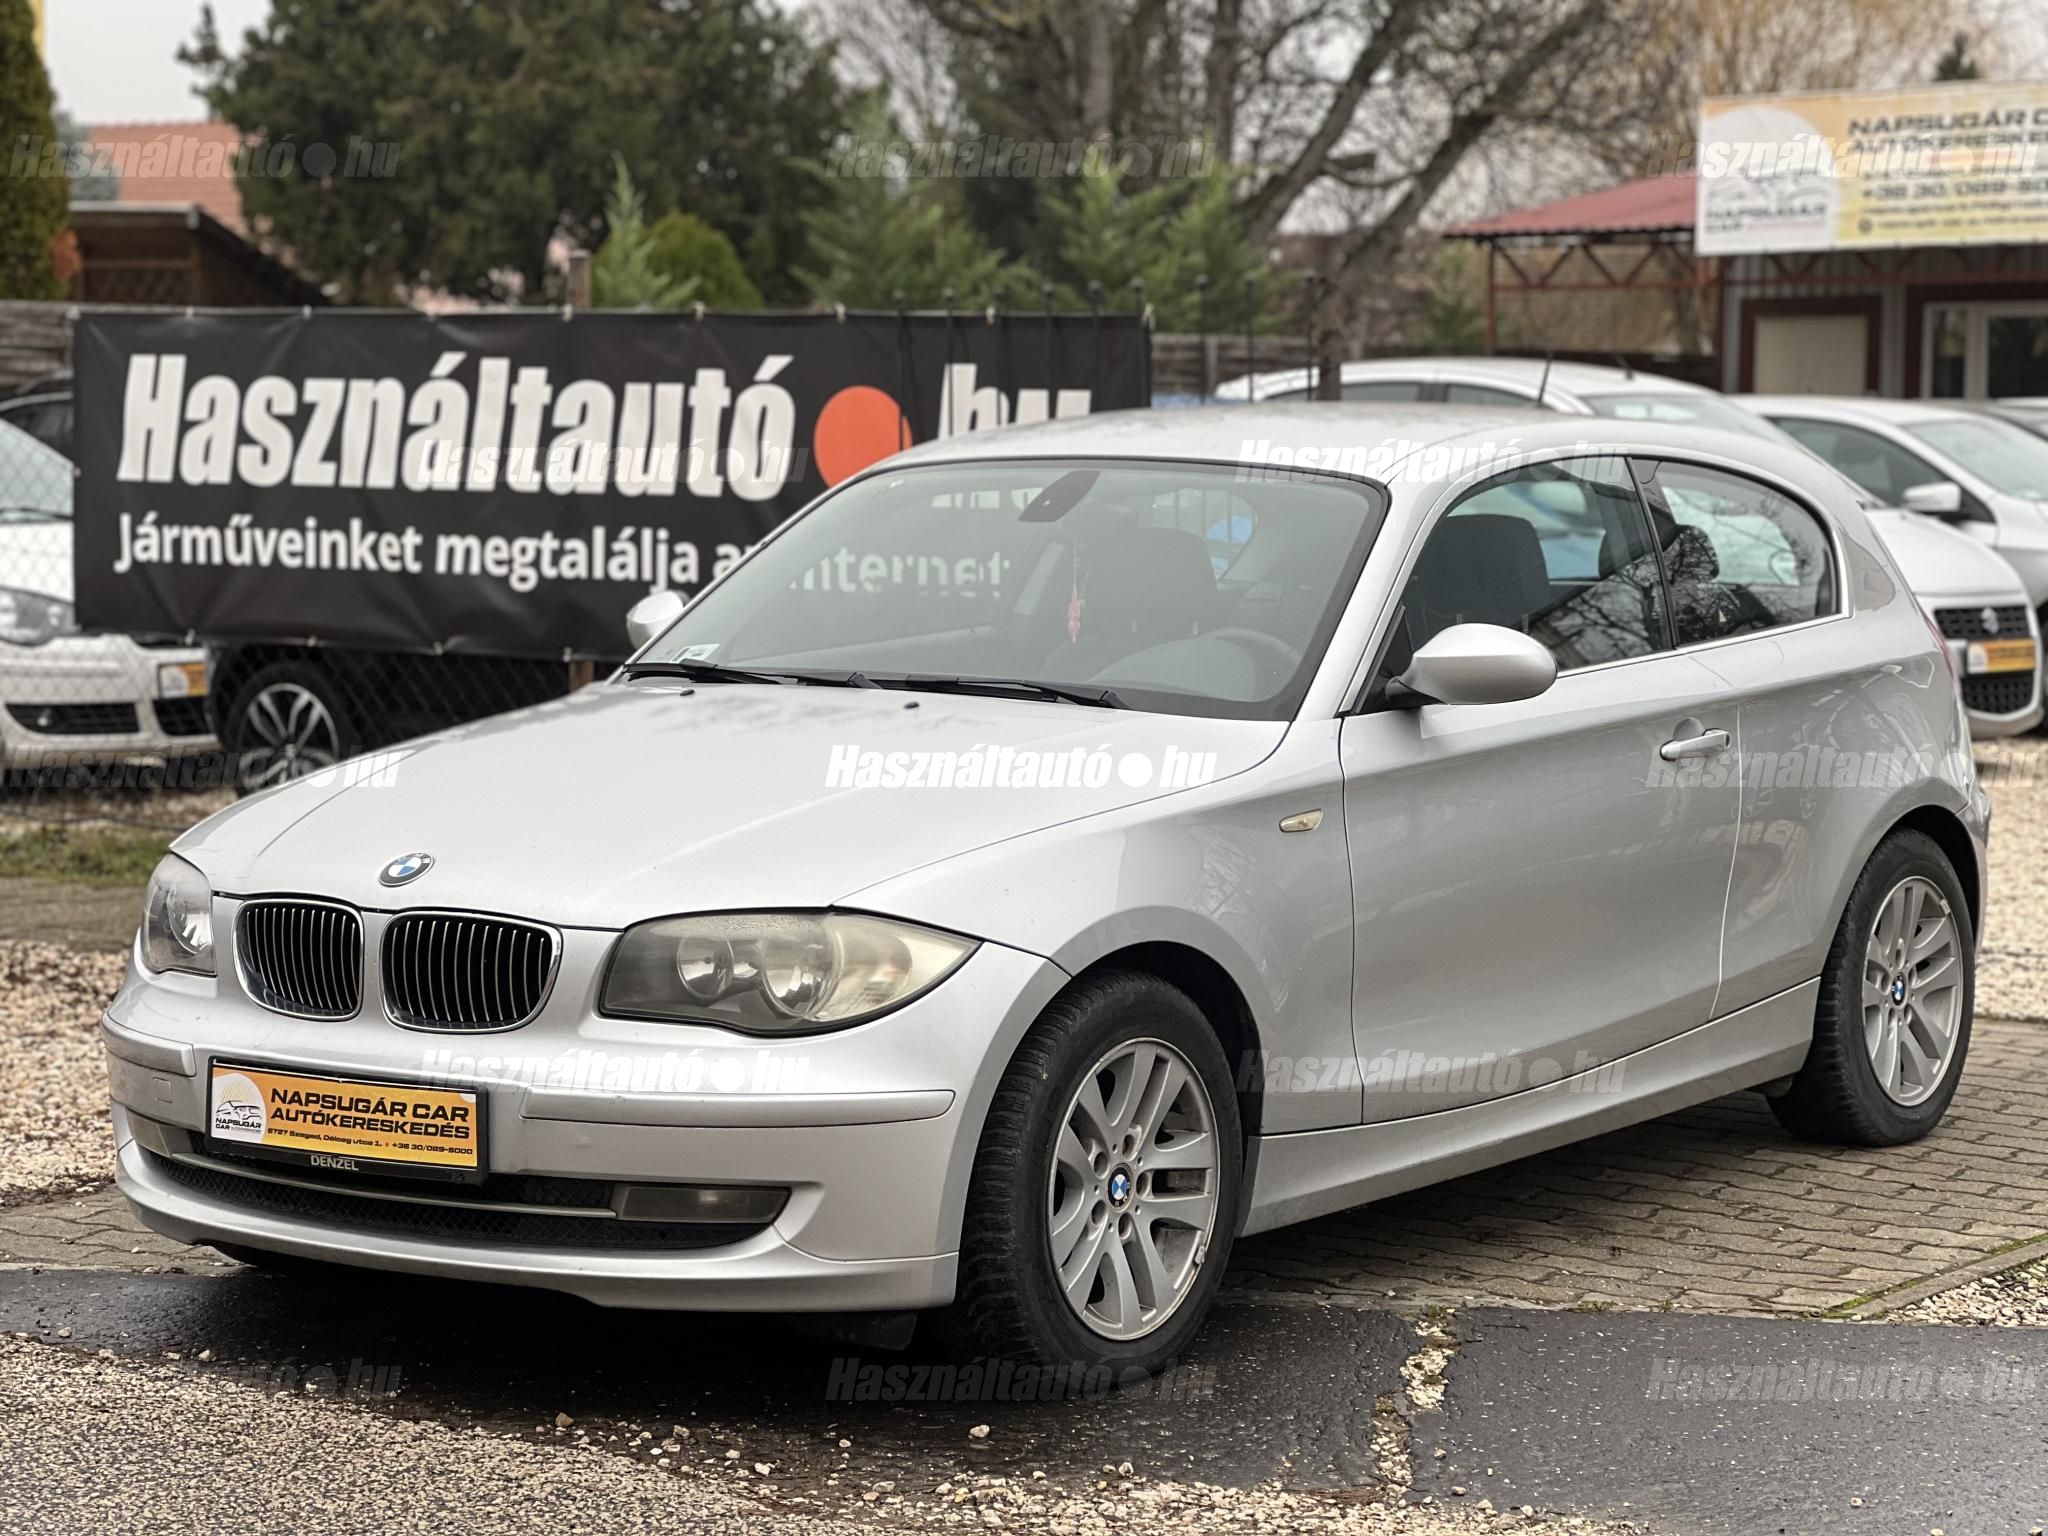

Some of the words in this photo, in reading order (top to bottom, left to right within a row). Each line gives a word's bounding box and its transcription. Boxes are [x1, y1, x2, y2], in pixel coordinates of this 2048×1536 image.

[117, 351, 795, 500] Használtautó
[113, 512, 422, 573] Járműveinket
[435, 526, 699, 592] megtalálja
[270, 1088, 408, 1118] NAPSUGÁR
[412, 1103, 469, 1123] CAR
[215, 1118, 262, 1129] NAPSUGÁR
[270, 1107, 470, 1139] AUTÓKERESKEDÉS
[310, 1154, 360, 1171] DENZEL
